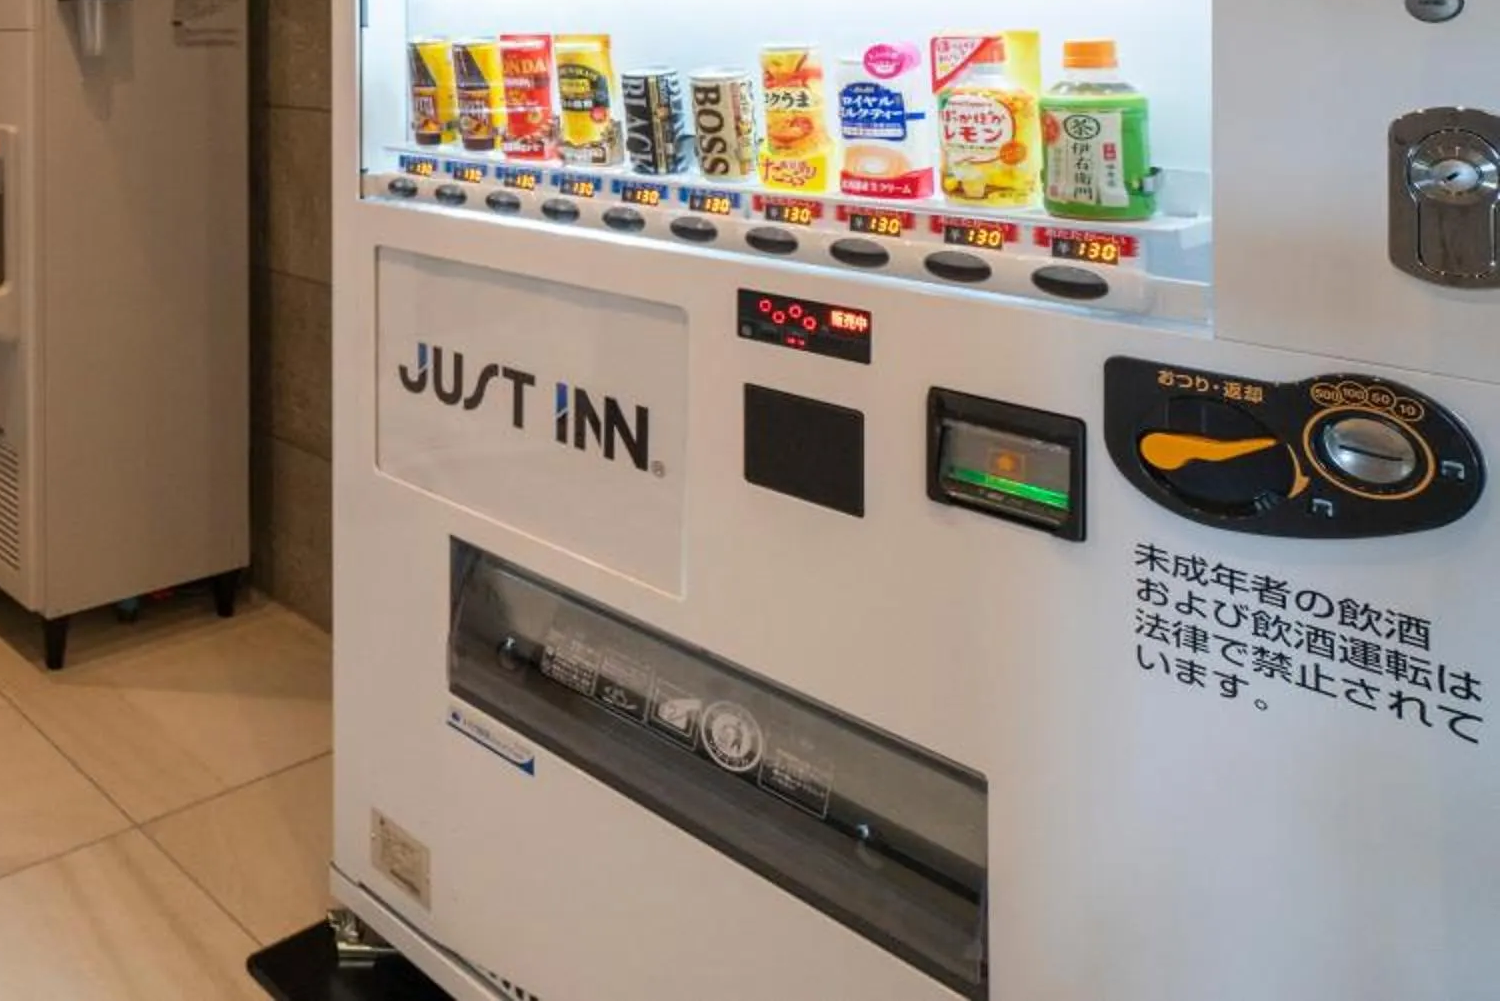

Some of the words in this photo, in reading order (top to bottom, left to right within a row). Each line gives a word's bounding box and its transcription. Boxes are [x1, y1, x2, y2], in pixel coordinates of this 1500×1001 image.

[693, 83, 730, 175] BOSS
[943, 124, 1003, 143] レモン
[635, 188, 660, 206] 130
[703, 197, 730, 215] 130
[782, 206, 810, 224] 130
[869, 216, 901, 237] 130
[966, 230, 1002, 248] 130
[1076, 243, 1117, 263] 130
[399, 341, 536, 430] JUST
[1157, 369, 1264, 404] おつり・返却
[1314, 388, 1340, 402] 500
[1342, 388, 1364, 401] 100
[1134, 542, 1432, 652] 未成年者の飲酒
[1135, 576, 1483, 703] および飲酒運転は
[1134, 607, 1484, 745] 法律で禁止されて
[1136, 643, 1269, 712] います。
